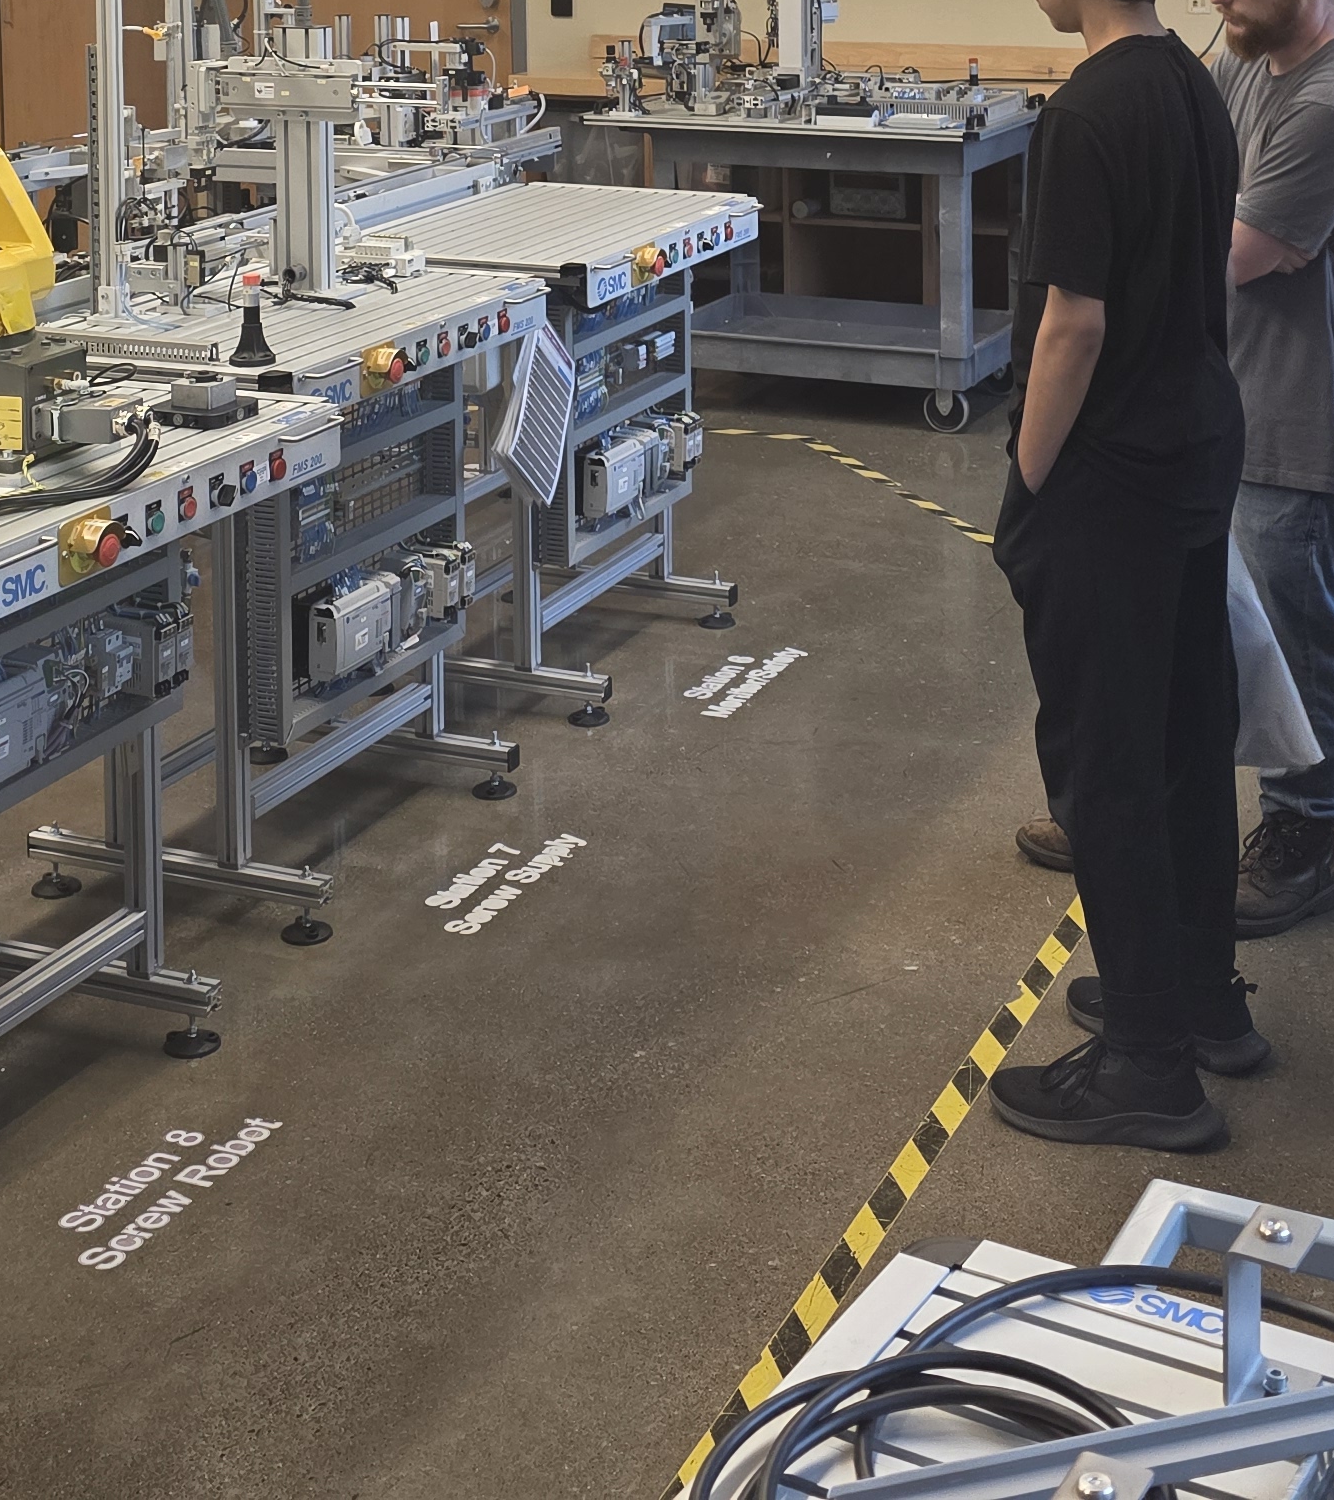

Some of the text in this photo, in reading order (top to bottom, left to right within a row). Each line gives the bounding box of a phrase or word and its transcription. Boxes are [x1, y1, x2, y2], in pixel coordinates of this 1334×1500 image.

[607, 271, 627, 295] SMC
[512, 319, 524, 332] FMS
[325, 379, 353, 405] SMC
[292, 453, 323, 475] FMS 200
[1, 563, 46, 608] SMC
[683, 655, 755, 700] Station 6
[700, 646, 809, 718] Monitor/Safety
[424, 842, 521, 909] Station 7
[443, 833, 588, 935] Screw Supply
[58, 1129, 205, 1232] Station 8
[77, 1117, 284, 1270] Screw Robot
[1135, 1294, 1224, 1334] SMC
